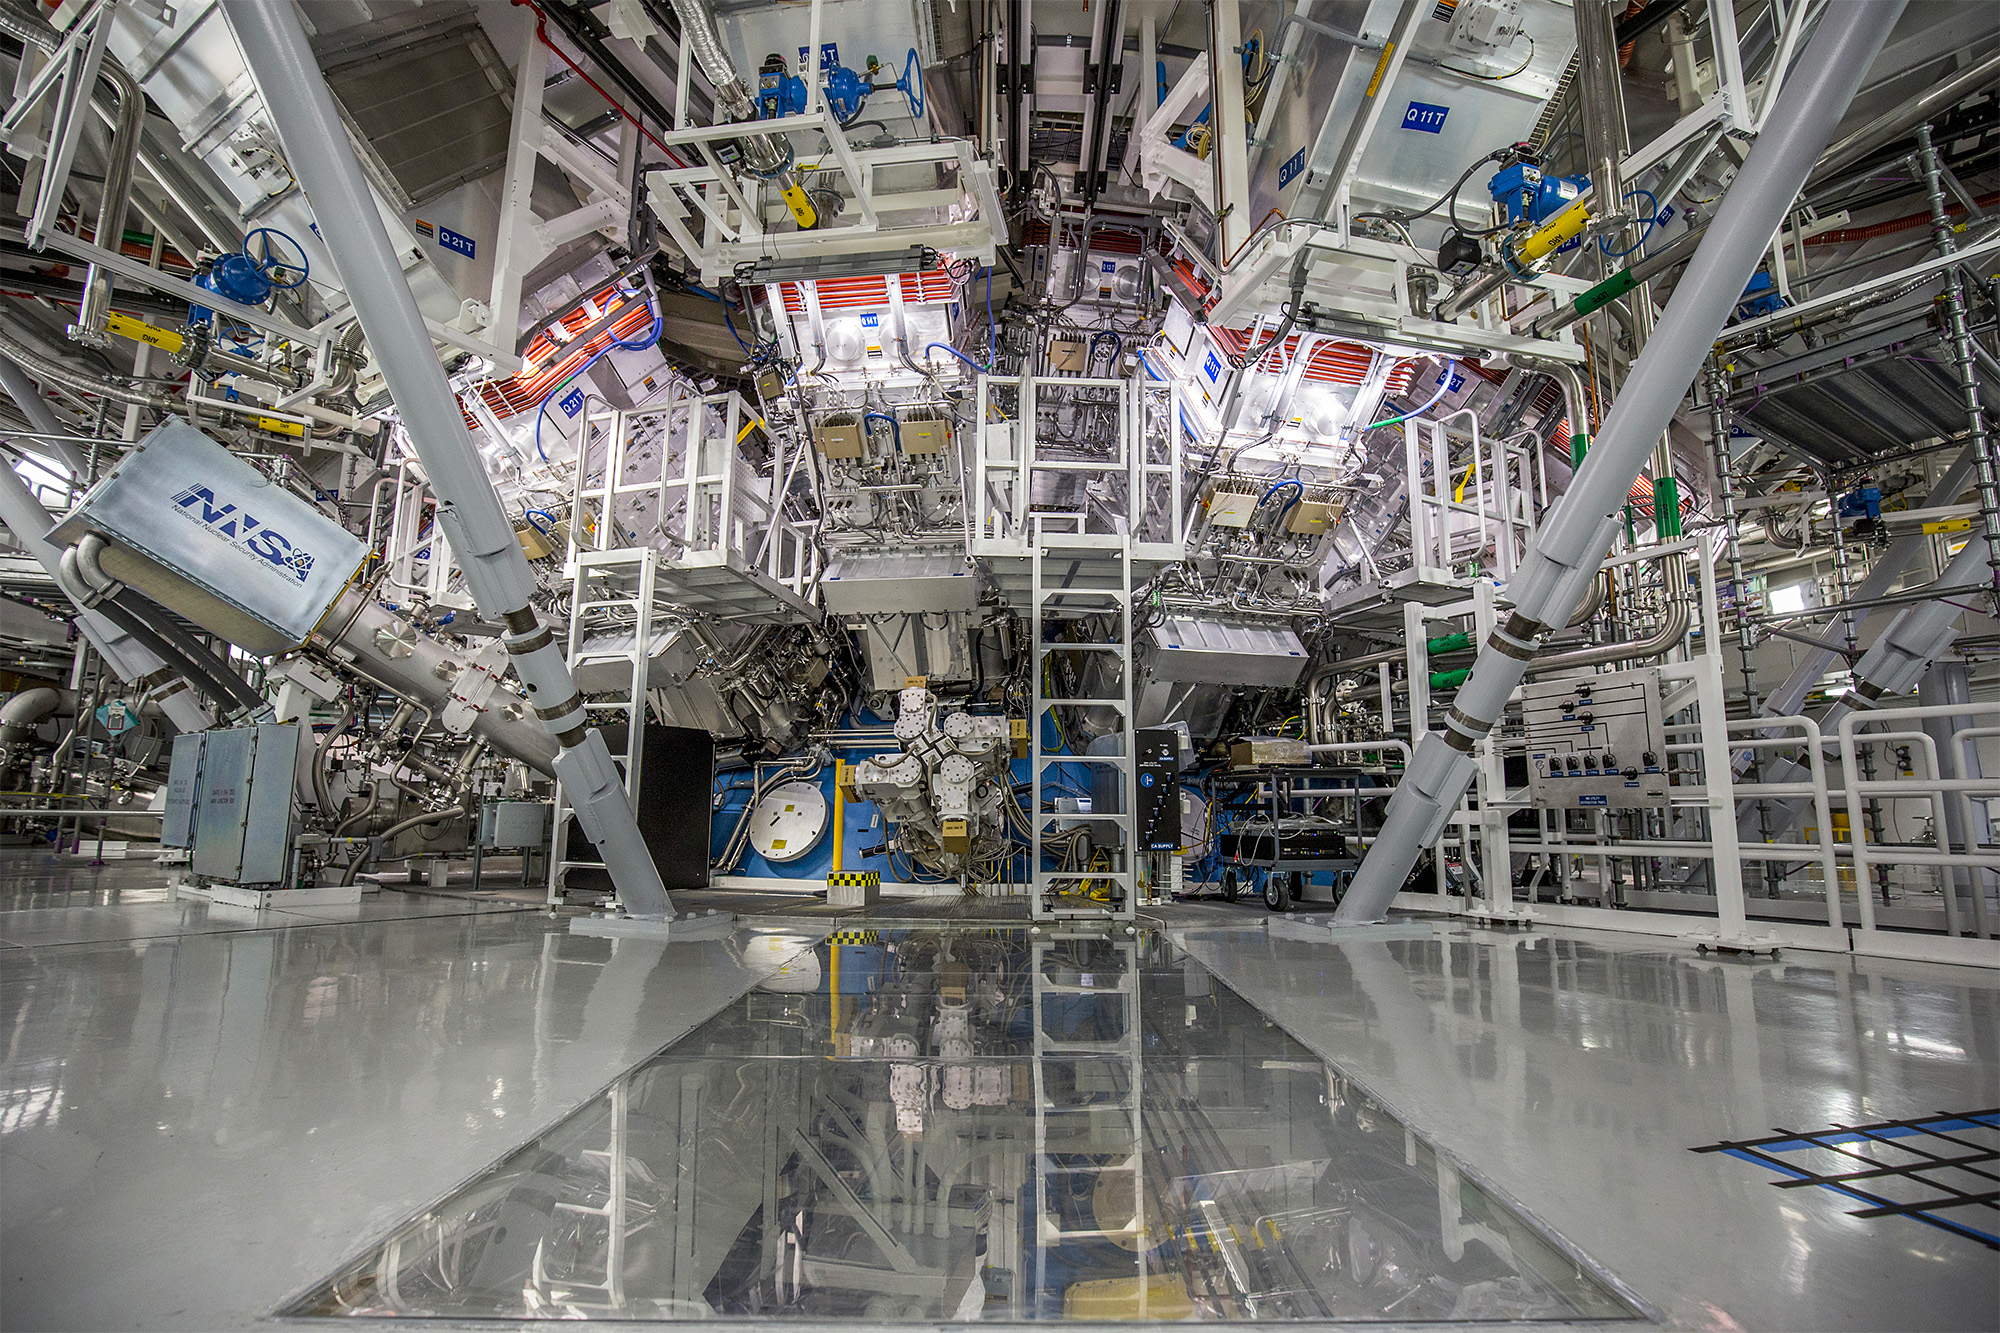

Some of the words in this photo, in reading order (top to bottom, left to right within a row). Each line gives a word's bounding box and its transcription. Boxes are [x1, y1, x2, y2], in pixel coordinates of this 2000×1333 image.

[1407, 108, 1418, 122] Q
[1420, 111, 1432, 123] 11
[1435, 113, 1445, 126] T
[441, 232, 450, 243] Q
[452, 236, 464, 249] 21
[465, 241, 473, 252] T
[1548, 234, 1564, 246] ARG
[142, 333, 159, 344] ARG
[171, 504, 202, 526] National
[202, 522, 230, 544] Nuclear
[229, 539, 258, 561] Security
[257, 558, 303, 588] Administration
